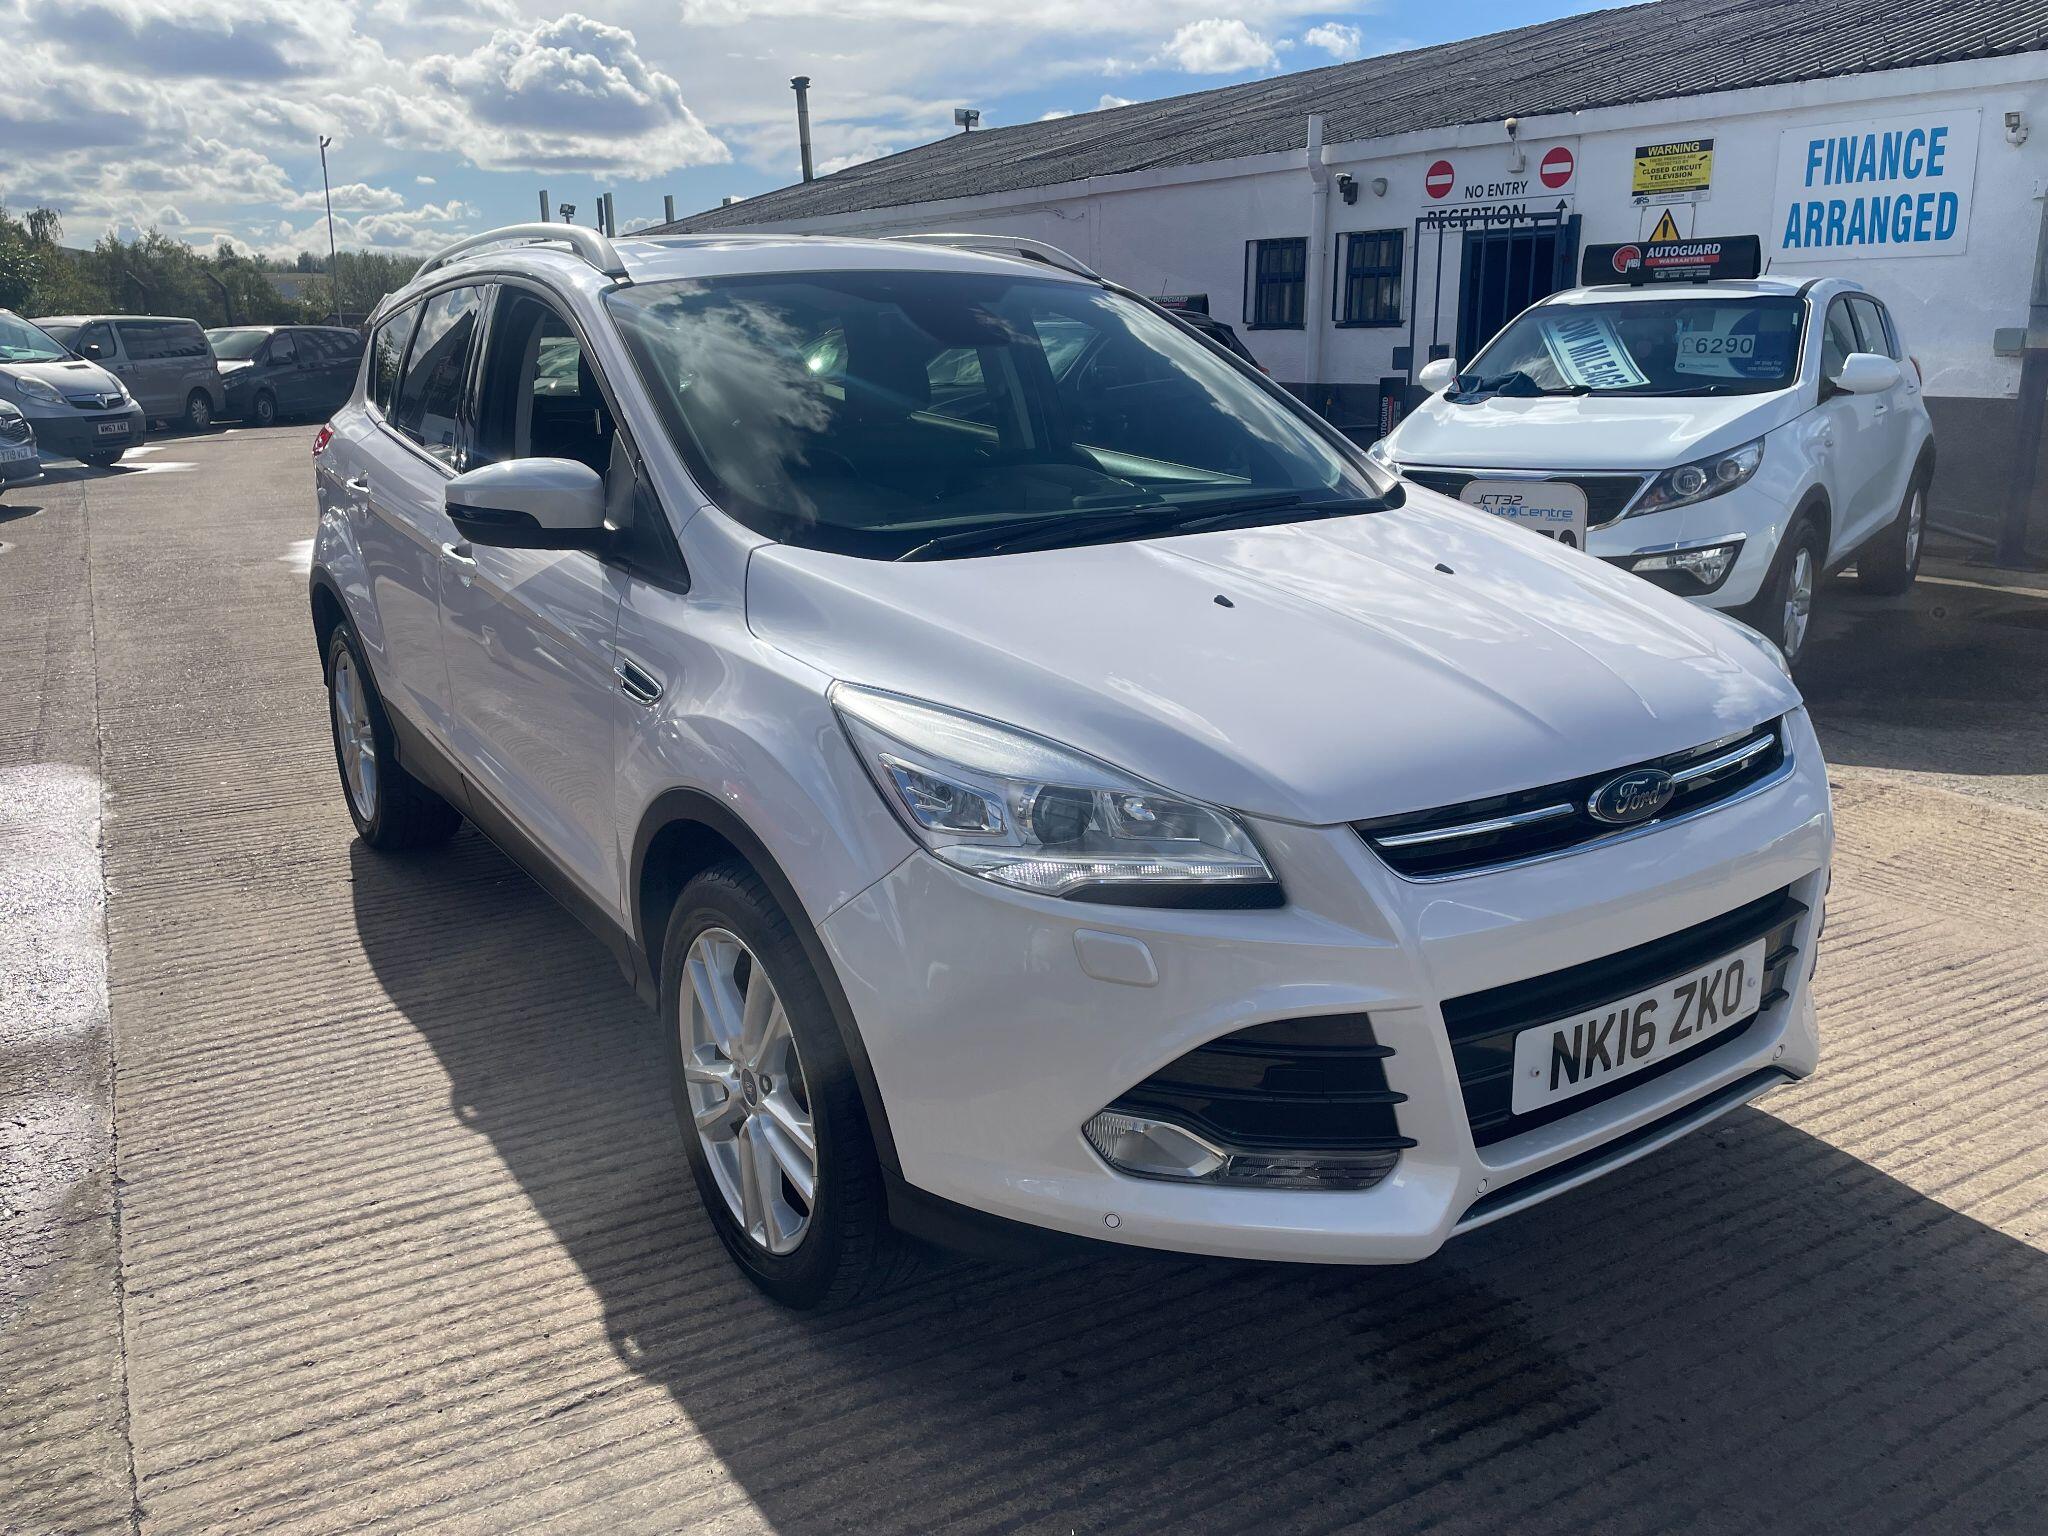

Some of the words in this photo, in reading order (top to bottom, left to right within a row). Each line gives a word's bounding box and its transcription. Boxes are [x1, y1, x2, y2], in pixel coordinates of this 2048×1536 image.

[1648, 142, 1700, 157] WARNING
[1805, 127, 1948, 187] FINANCE
[1642, 166, 1670, 175] CLOSED
[1671, 163, 1703, 172] CIRCUIT
[1650, 171, 1693, 181] TELEVISION
[1465, 184, 1484, 199] NO
[1487, 180, 1529, 197] ENTRY
[1782, 191, 1959, 249] ARRANGED
[1646, 243, 1721, 258] AUTOGUARD
[1681, 336, 1753, 354] £6290
[1381, 396, 1389, 437] UTOGUARD
[1473, 494, 1523, 506] JCT32
[1615, 778, 1661, 814] Ford
[1550, 998, 1658, 1091] NK16
[1669, 959, 1744, 1045] ZKO
